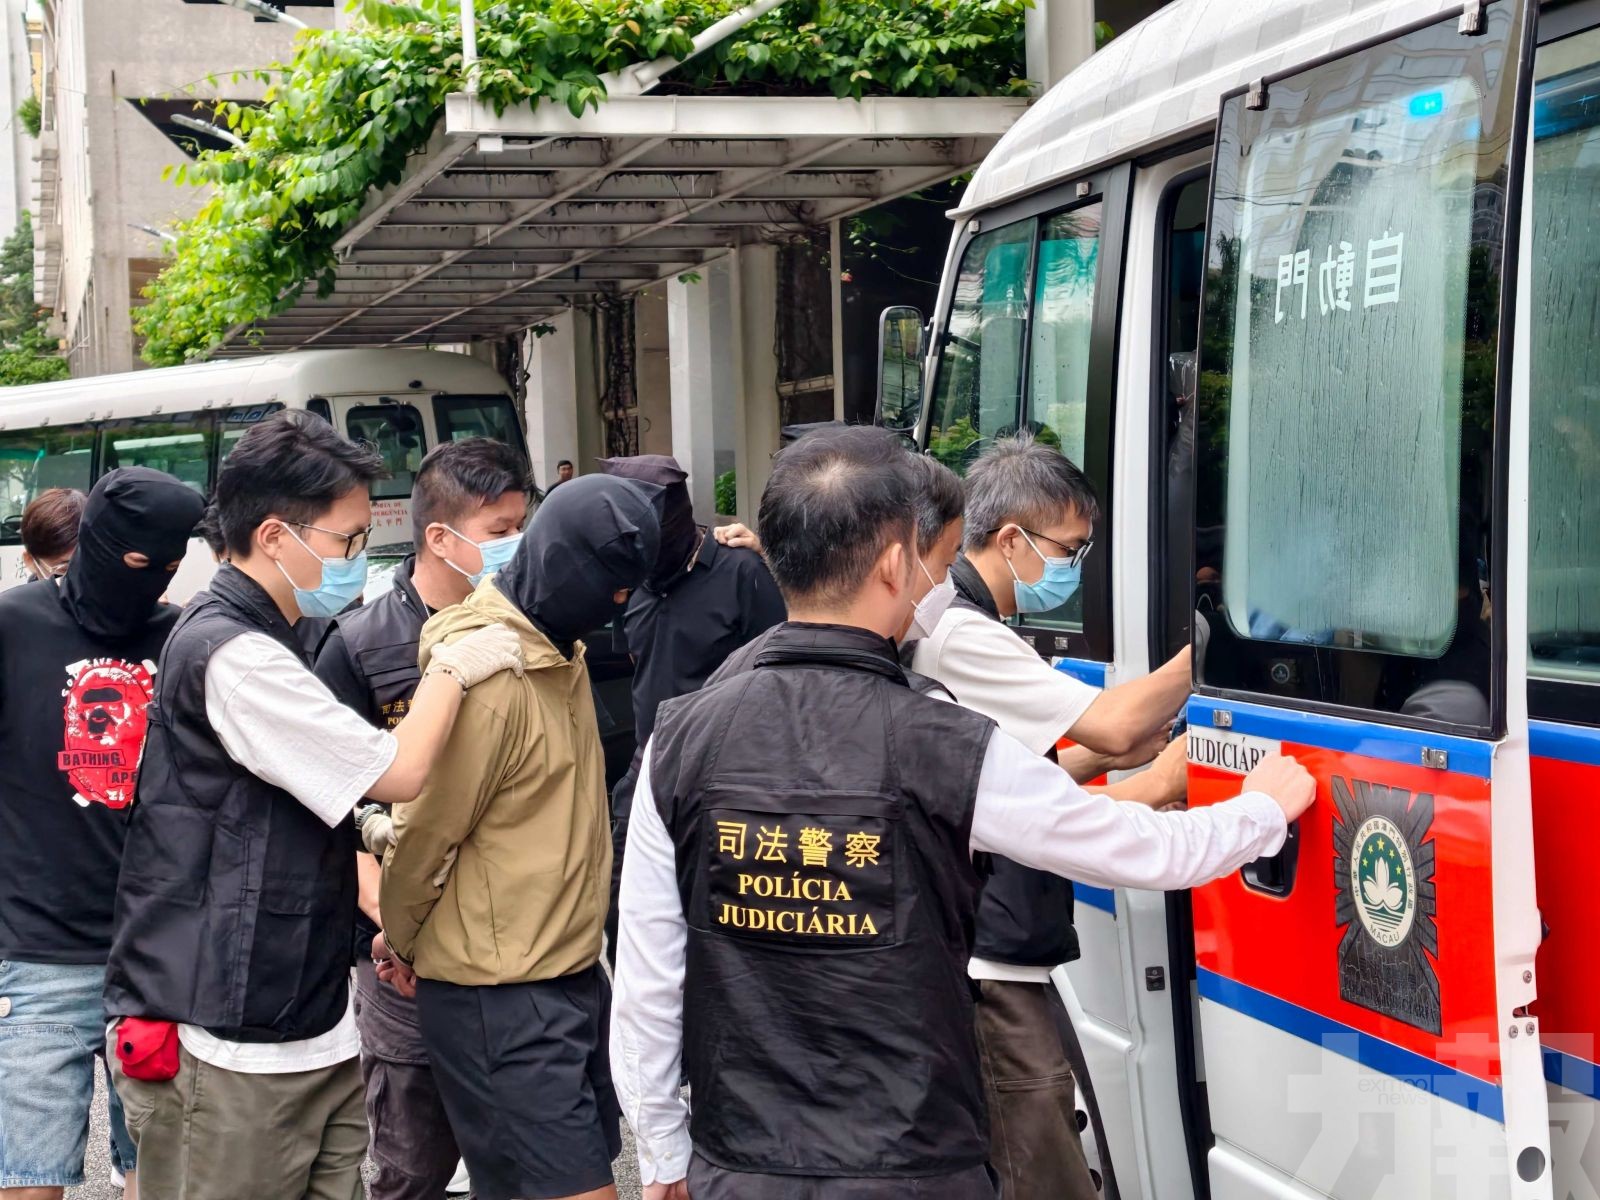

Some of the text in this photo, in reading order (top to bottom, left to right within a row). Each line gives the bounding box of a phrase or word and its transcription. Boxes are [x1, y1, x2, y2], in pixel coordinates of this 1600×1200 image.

[62, 751, 121, 767] BATHING
[1187, 736, 1267, 772] JUDICIÁR
[717, 820, 881, 868] 司法警察
[738, 871, 853, 901] POLÍCIA
[718, 904, 879, 935] JUDICIÁRIA
[1370, 923, 1400, 945] MACAU
